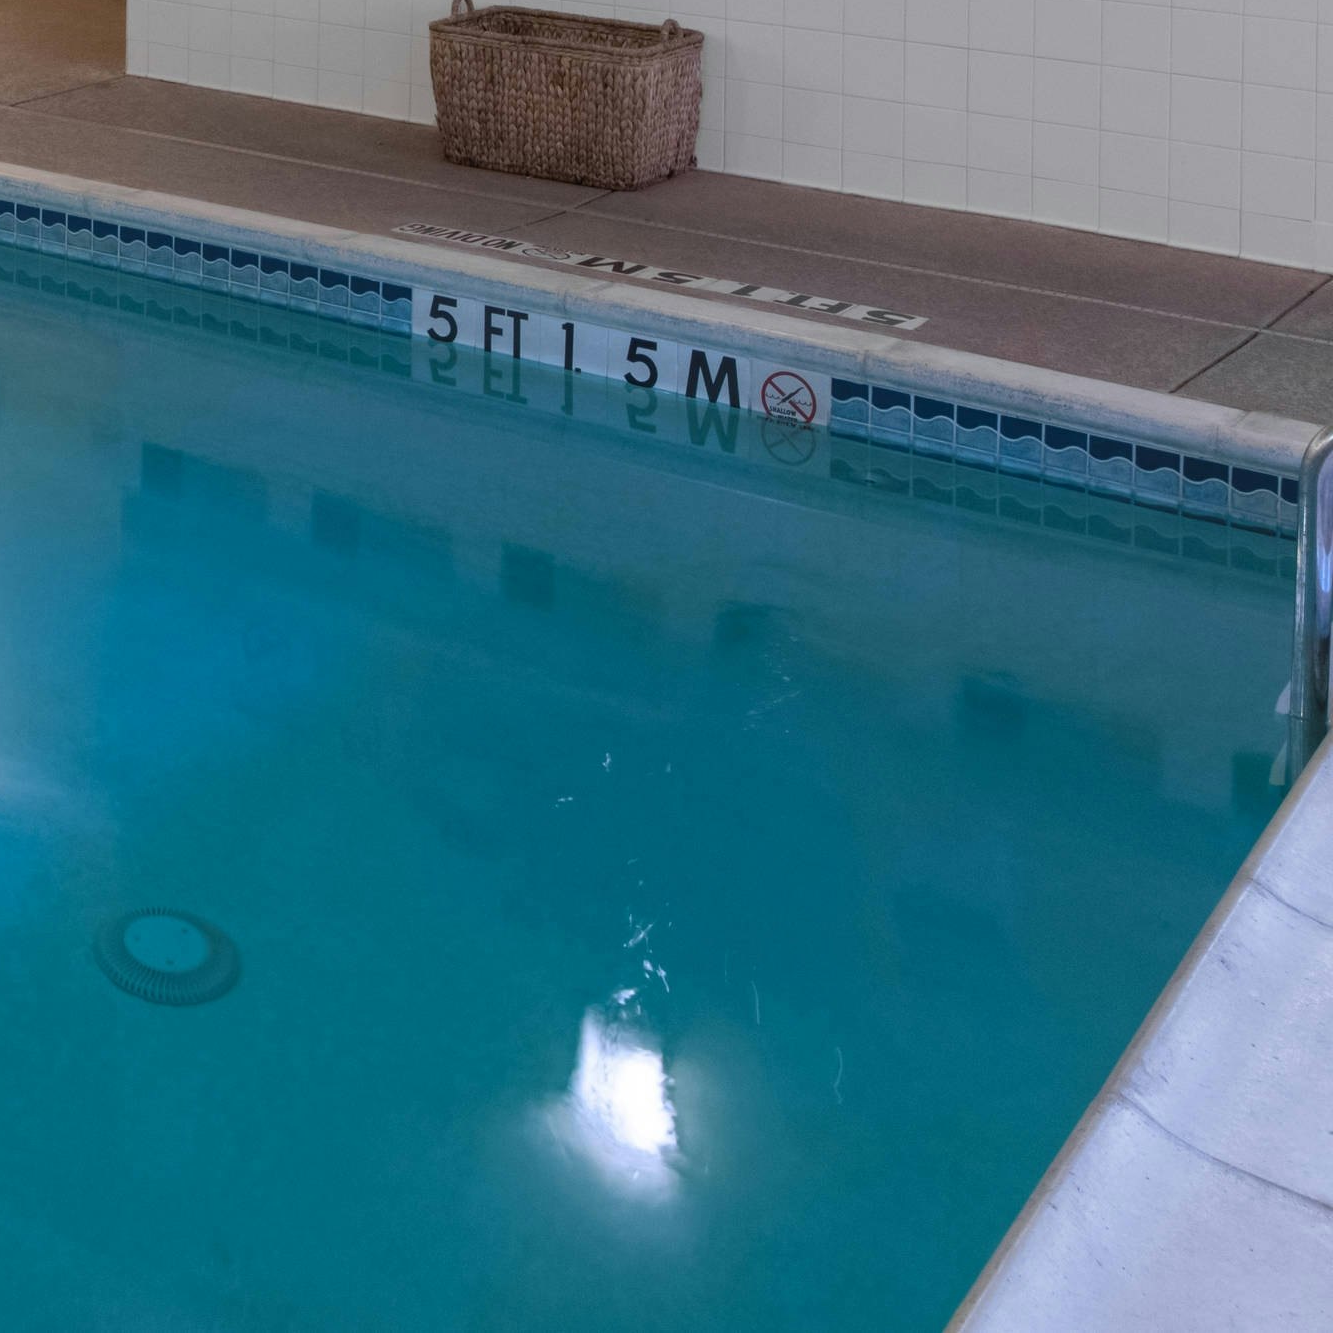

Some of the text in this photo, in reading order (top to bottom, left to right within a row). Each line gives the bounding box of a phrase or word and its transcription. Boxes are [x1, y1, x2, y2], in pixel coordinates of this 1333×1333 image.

[399, 223, 487, 243] DIVING
[482, 239, 522, 250] NO
[576, 256, 648, 274] M
[651, 272, 703, 284] 5
[862, 311, 915, 325] 5
[427, 295, 458, 343] 5
[484, 304, 529, 359] FT
[624, 337, 658, 388] 5
[686, 349, 740, 408] M
